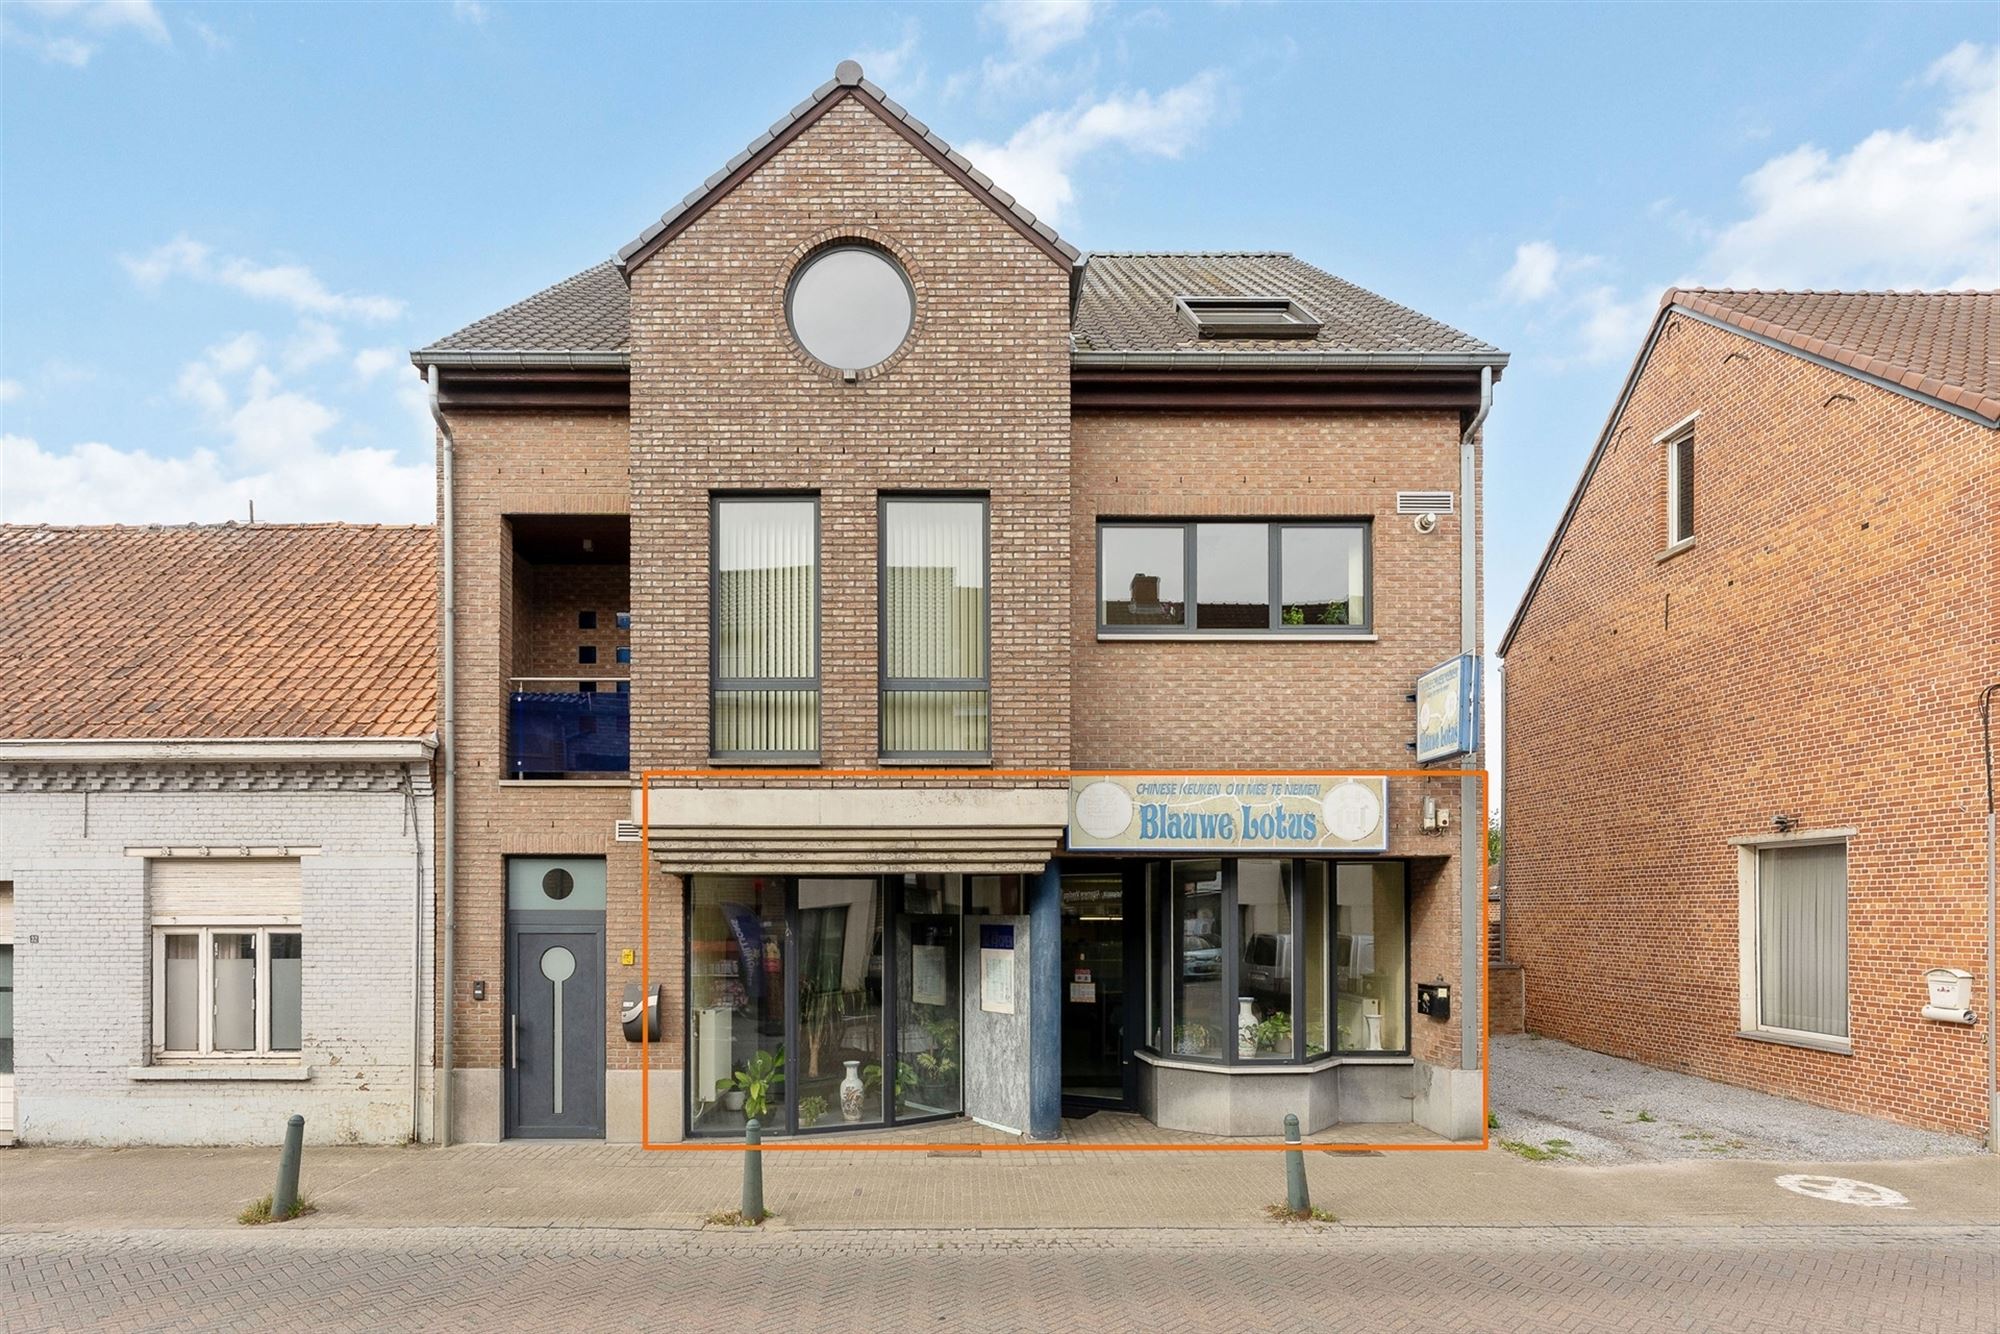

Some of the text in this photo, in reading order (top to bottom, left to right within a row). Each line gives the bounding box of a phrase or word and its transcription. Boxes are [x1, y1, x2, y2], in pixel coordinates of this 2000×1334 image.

[1136, 783, 1321, 795] CHINESE KEUKEN OM MEE TE NEMEN
[1139, 803, 1233, 840] Blauwe
[1241, 804, 1317, 840] Lotus
